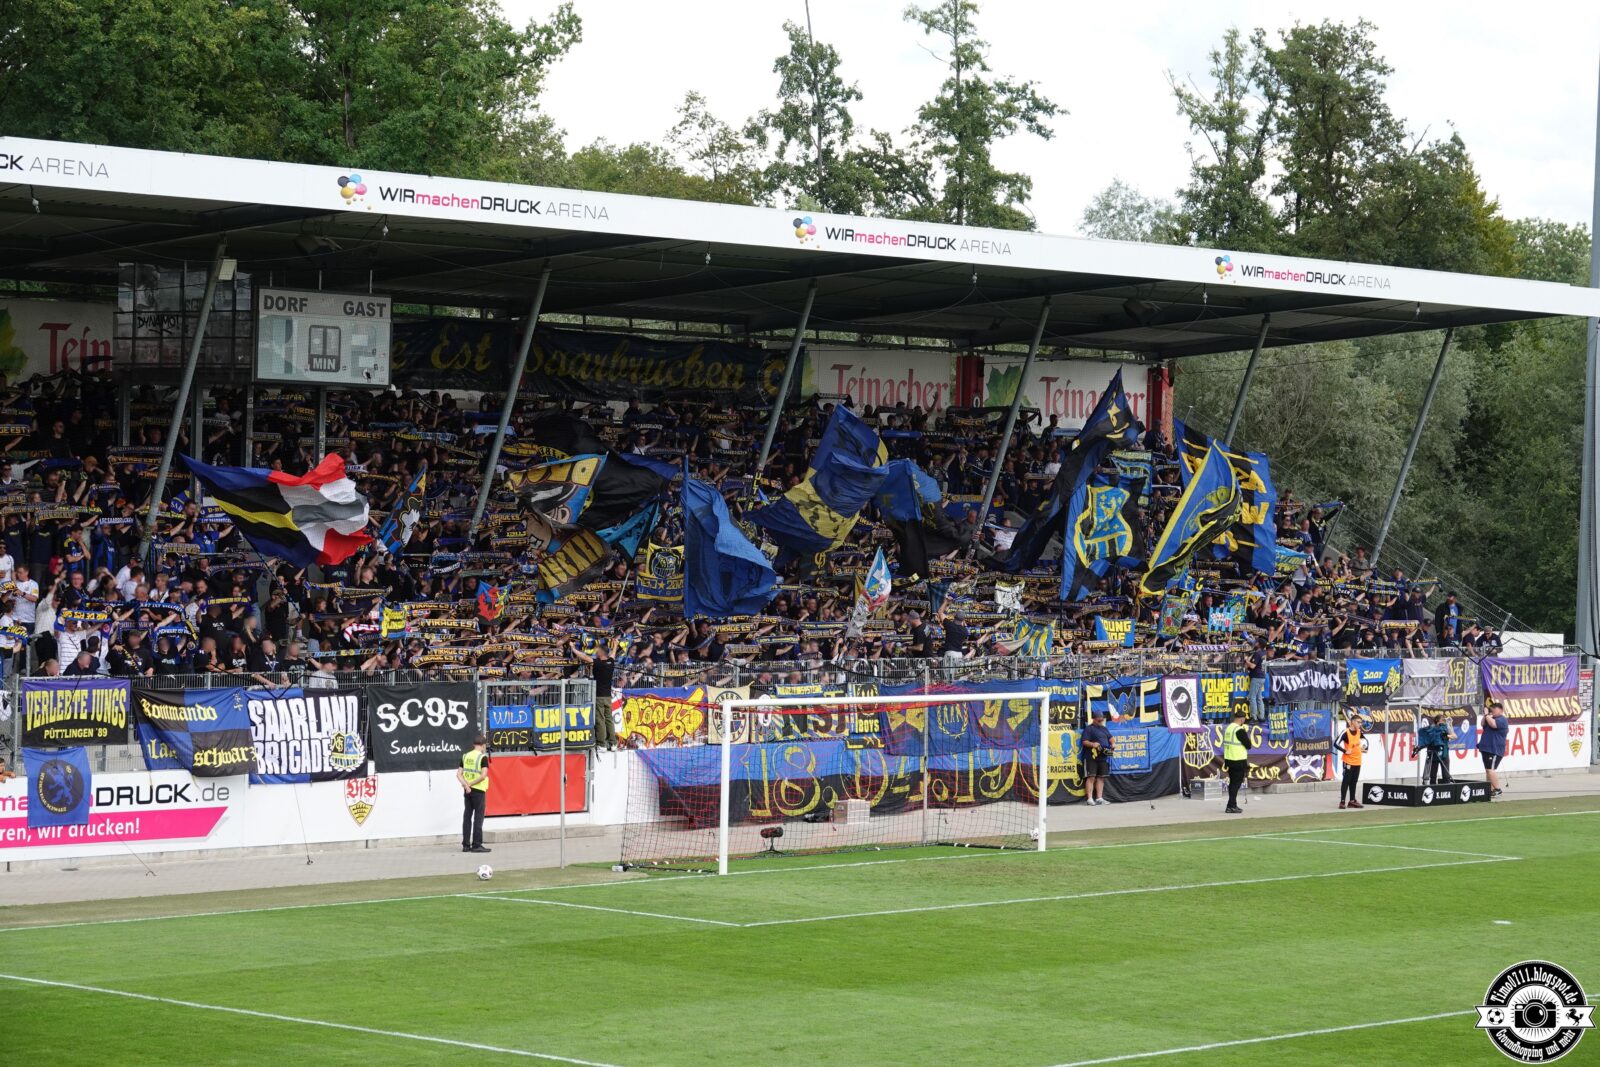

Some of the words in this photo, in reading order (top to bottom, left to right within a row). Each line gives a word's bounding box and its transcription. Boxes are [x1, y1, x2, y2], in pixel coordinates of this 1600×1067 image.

[29, 156, 109, 179] ARENA
[378, 186, 541, 215] WIRmachenDRUCK
[545, 201, 610, 221] ARENA
[825, 226, 957, 251] WIRmachenDRUCK
[960, 239, 1012, 256] ARENA
[1240, 264, 1346, 286] WIRmachenDRUCK
[1348, 275, 1391, 290] ARENA
[263, 295, 309, 312] DORF
[343, 300, 387, 318] GAST
[137, 314, 180, 329] DYNAMO!
[312, 357, 336, 371] MIN
[830, 363, 950, 413] Teinacher
[1363, 669, 1384, 681] Saar
[1491, 664, 1512, 686] FCS
[1513, 662, 1567, 685] FREUNDE
[1201, 678, 1234, 693] YOUNG
[1362, 684, 1383, 694] lions
[1205, 692, 1230, 707] SIDE
[26, 689, 88, 731] VERLEBTE
[90, 688, 127, 729] JUNGS
[140, 699, 218, 721] Kommando
[247, 695, 358, 741] SAARLAND
[376, 697, 469, 733] SC95
[491, 709, 528, 725] WILD
[535, 706, 592, 729] UNTY
[44, 728, 94, 740] PÜTTLINGEN
[858, 719, 880, 733] BOYS
[492, 730, 529, 745] CATS
[389, 739, 462, 755] Saarbrücken
[254, 738, 332, 775] BRIGADE
[1050, 765, 1076, 773] RACISME
[1394, 791, 1408, 800] LIGA
[1441, 791, 1451, 799] LIGA
[38, 825, 62, 840] wir
[68, 818, 140, 838] drucken!
